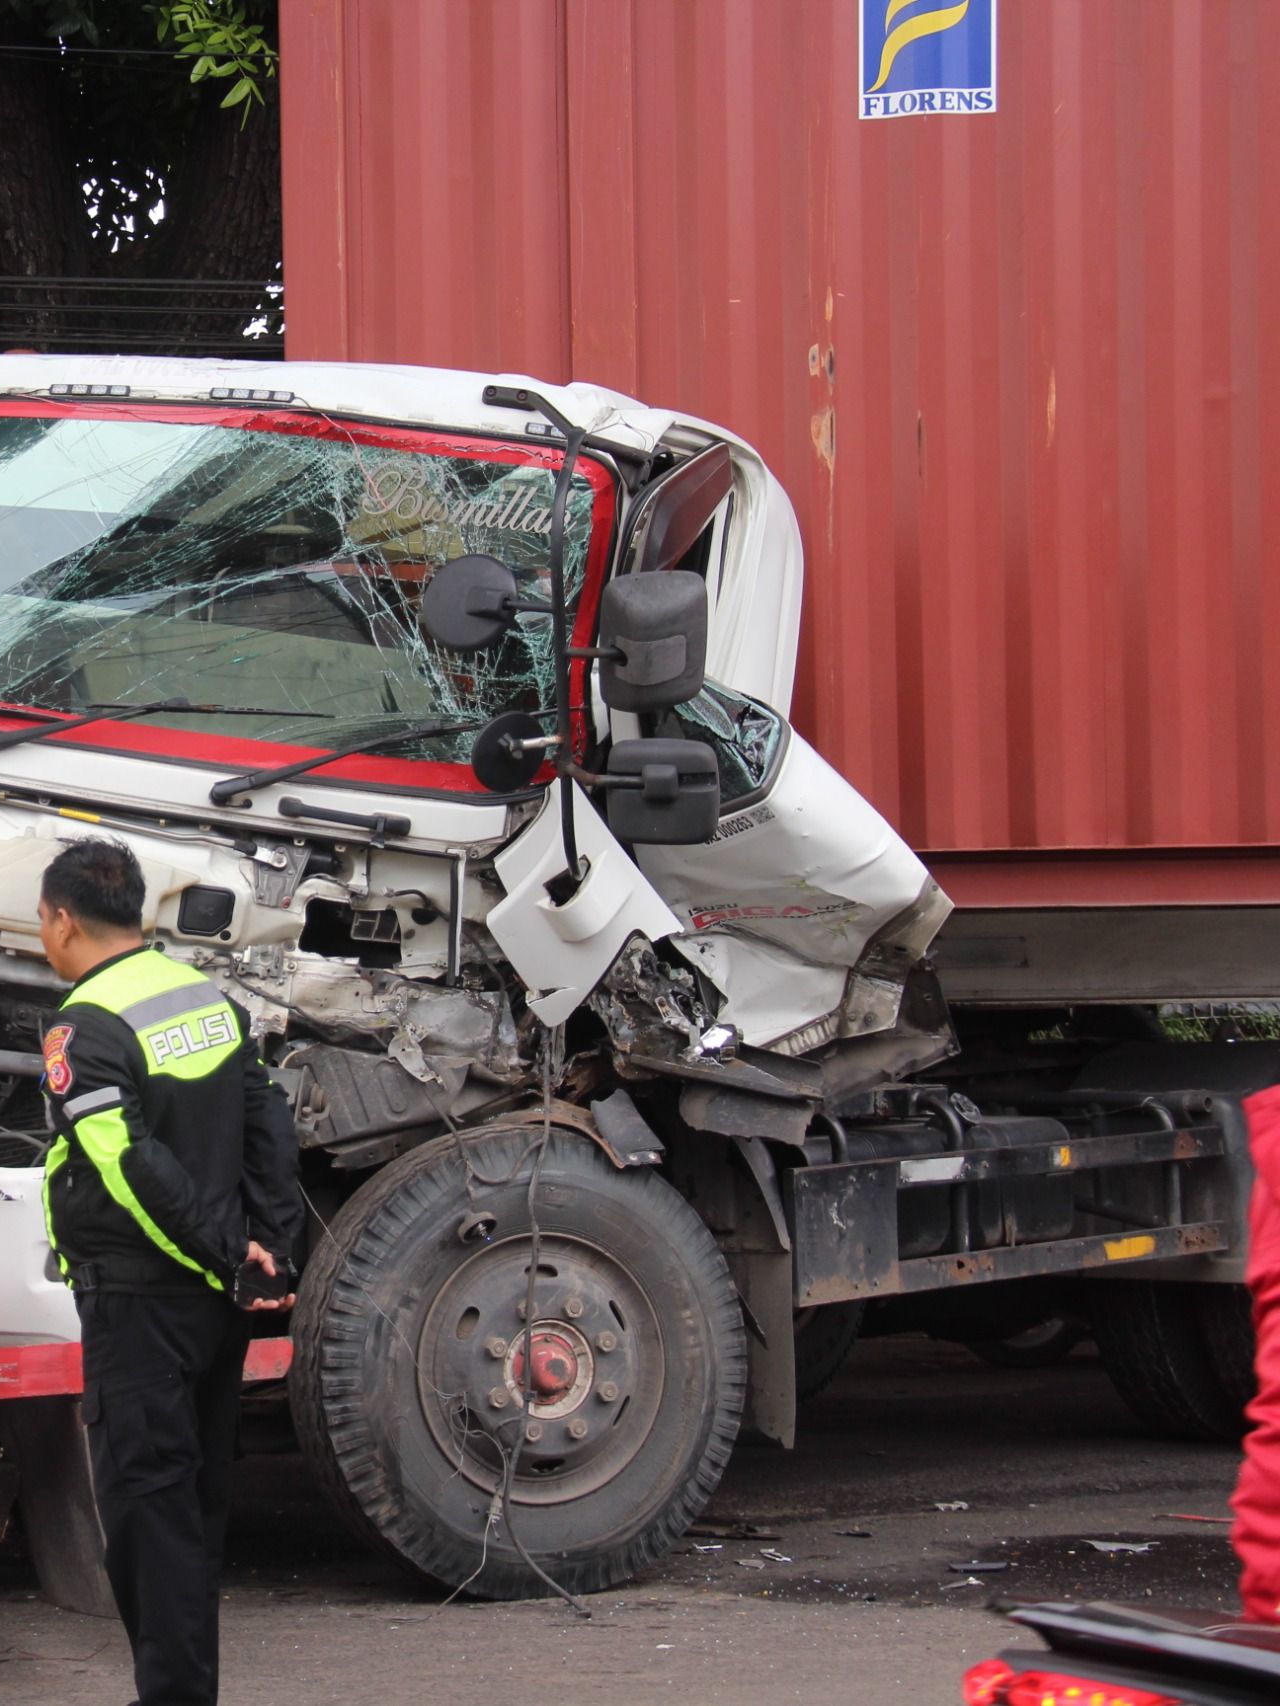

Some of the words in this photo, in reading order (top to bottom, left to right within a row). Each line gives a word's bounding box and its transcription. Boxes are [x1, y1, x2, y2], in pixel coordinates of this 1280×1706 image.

[863, 90, 994, 117] FLORENS
[687, 902, 739, 917] ISUZU
[690, 905, 815, 930] GIGA
[146, 1010, 237, 1067] POLISI
